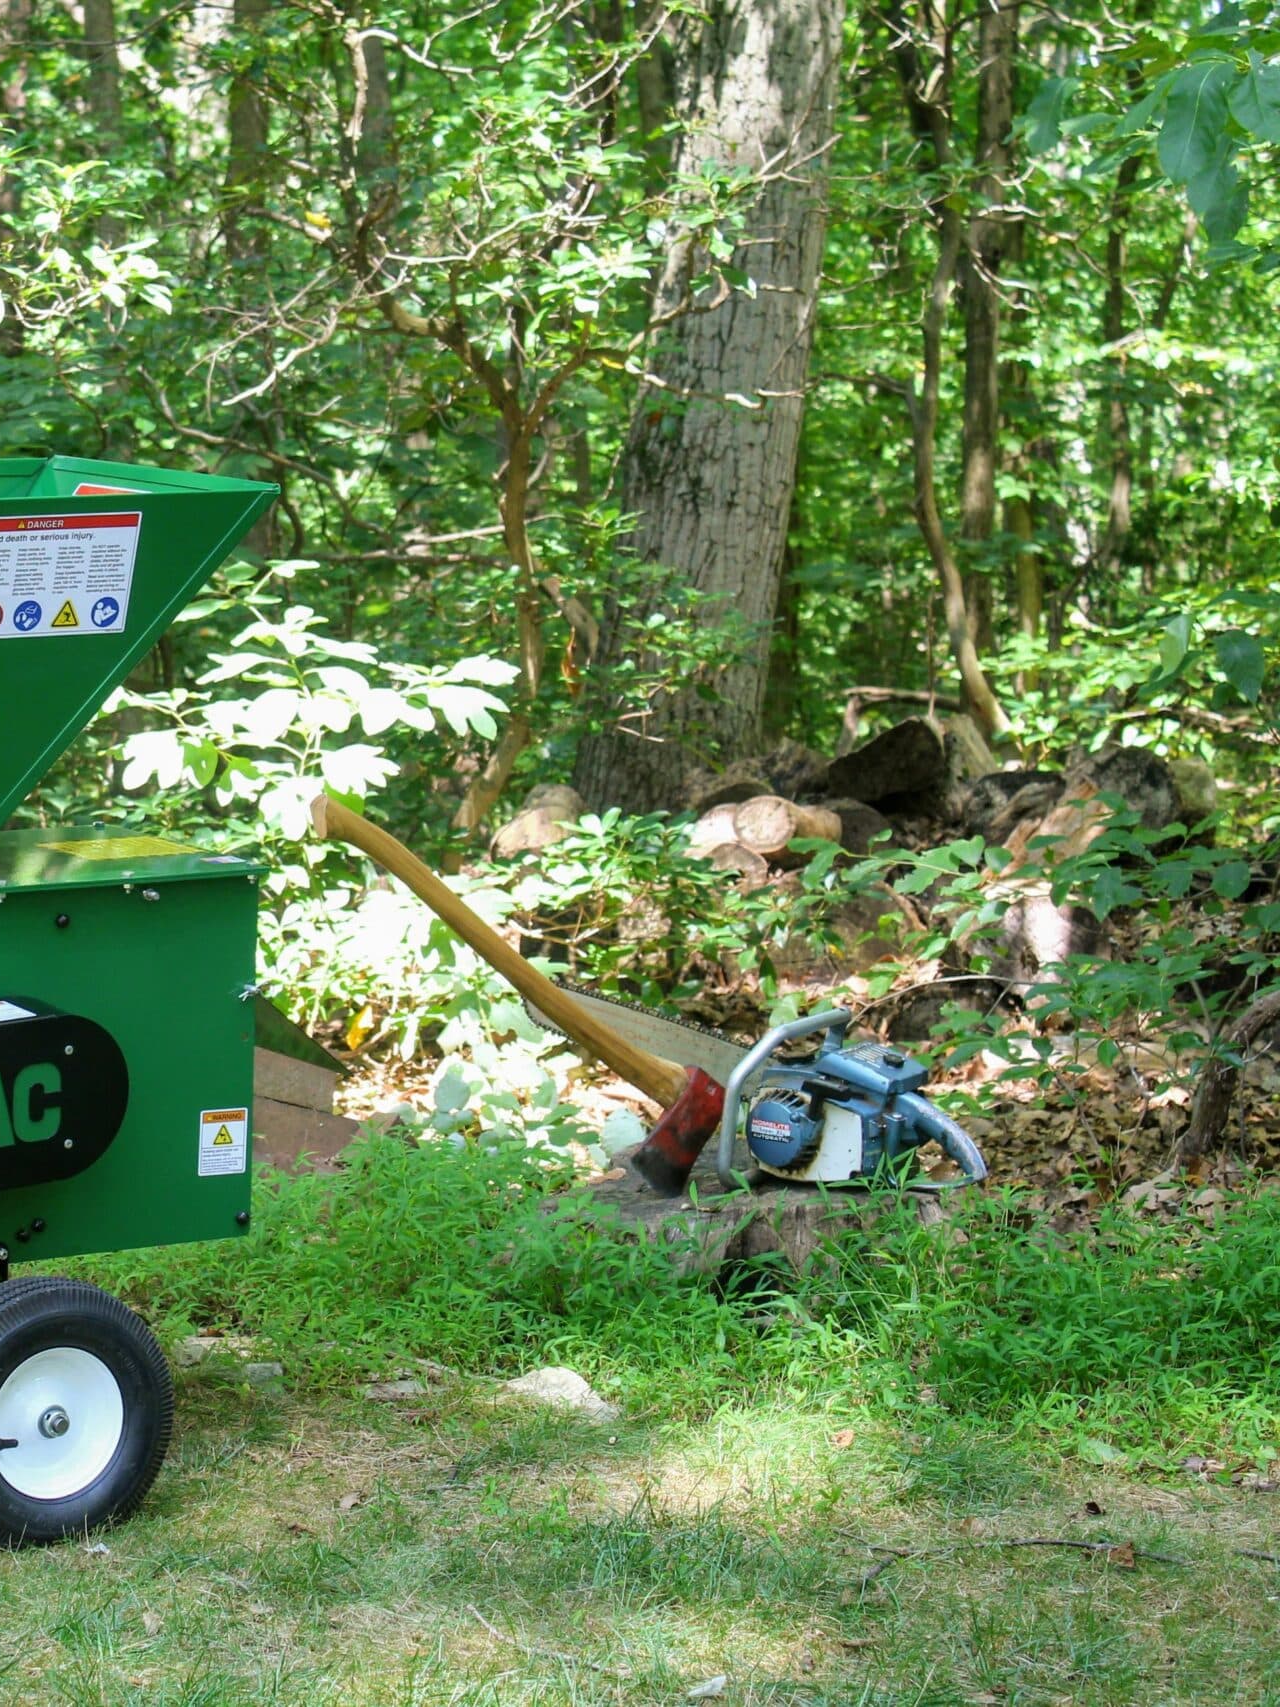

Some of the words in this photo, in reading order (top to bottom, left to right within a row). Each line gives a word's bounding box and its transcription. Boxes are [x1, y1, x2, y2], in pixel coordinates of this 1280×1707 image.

[27, 519, 64, 529] DANGER
[5, 534, 28, 543] death
[40, 532, 69, 541] serious
[213, 1112, 242, 1121] WARNING
